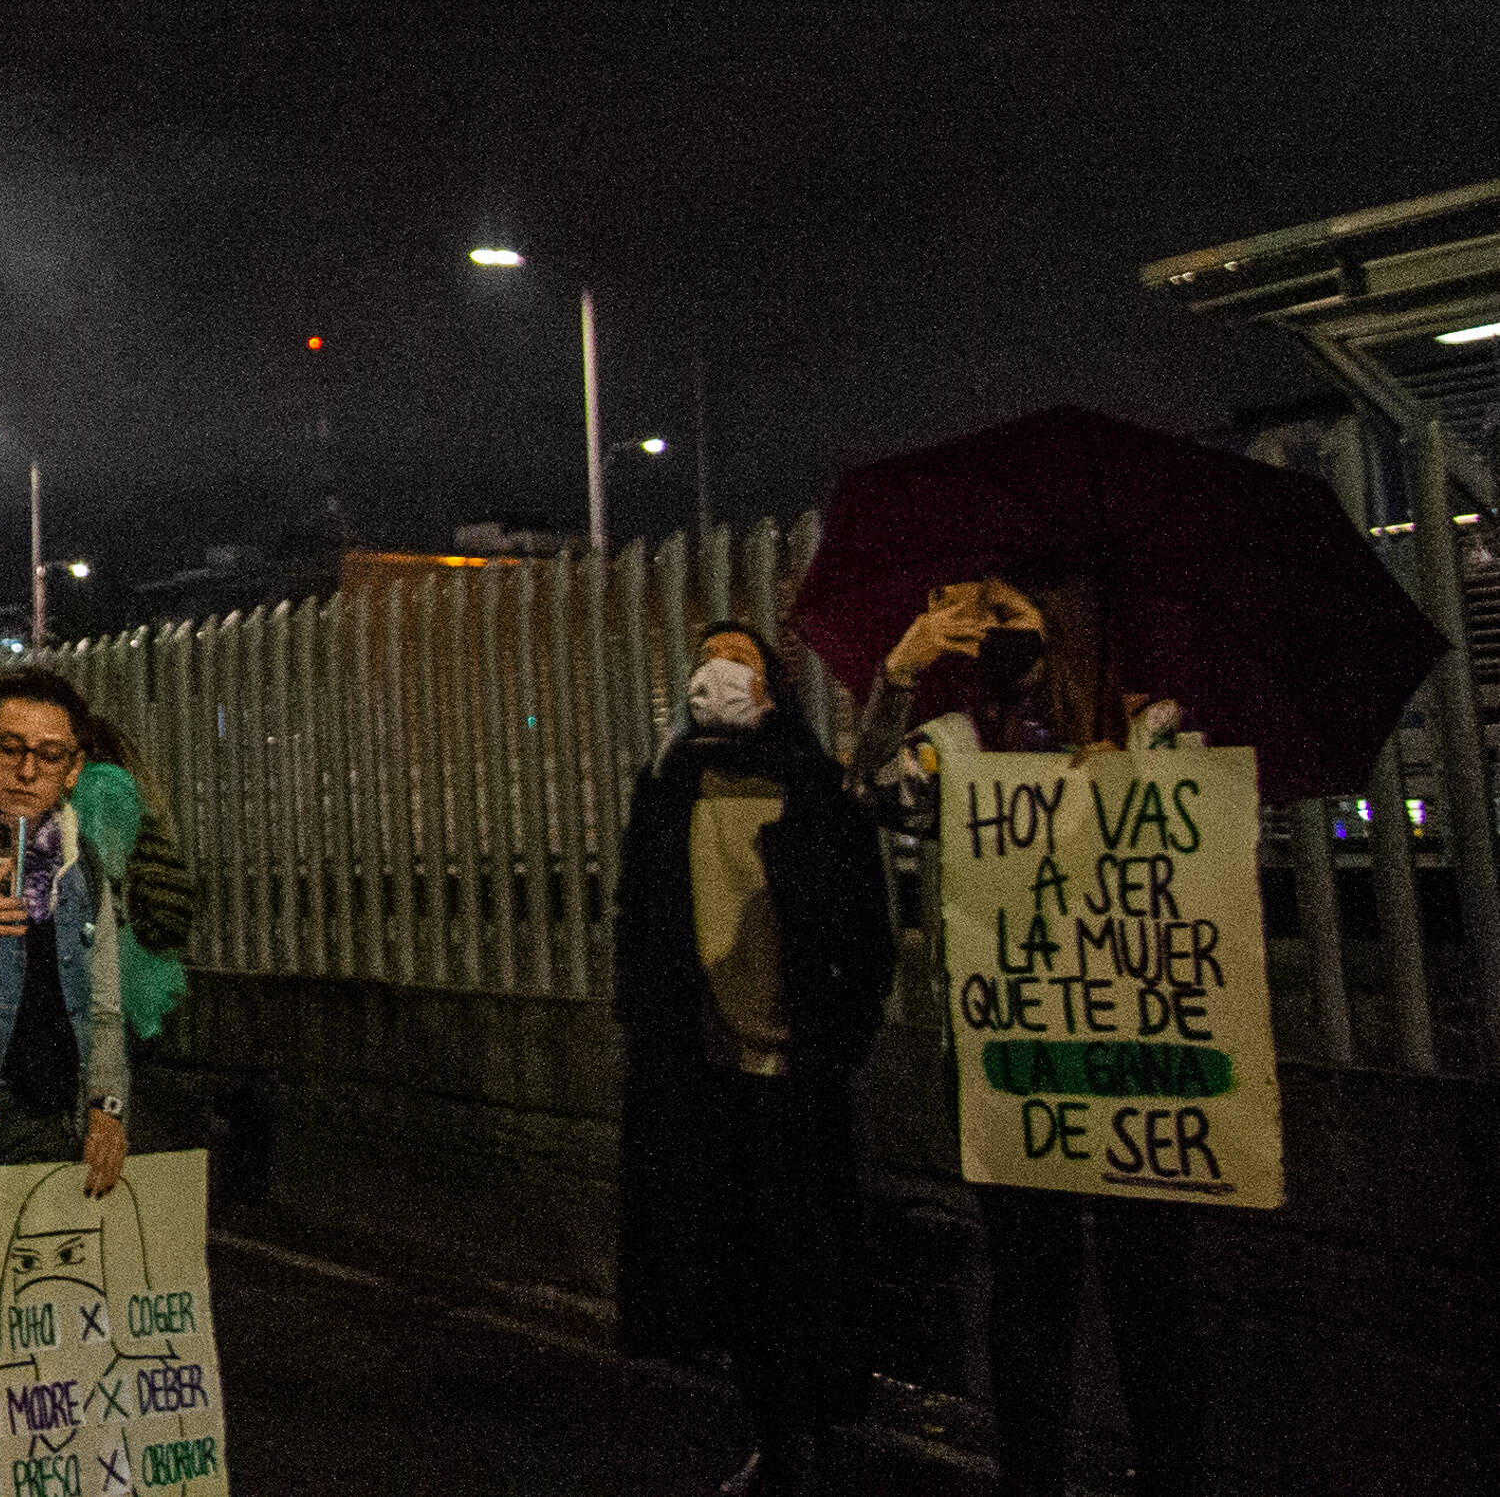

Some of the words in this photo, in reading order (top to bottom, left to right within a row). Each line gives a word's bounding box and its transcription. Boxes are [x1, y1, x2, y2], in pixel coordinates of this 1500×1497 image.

[967, 780, 1064, 858] HOY
[1091, 780, 1199, 853] VAS
[1031, 857, 1068, 915] A
[1085, 853, 1179, 918] SER
[999, 908, 1059, 975] LA
[1076, 918, 1225, 988] MUJER
[1138, 987, 1212, 1040] DE
[1023, 1100, 1090, 1159] DE
[1106, 1106, 1221, 1179] SER
[128, 1291, 197, 1339] COGER
[137, 1364, 209, 1416] DEBER
